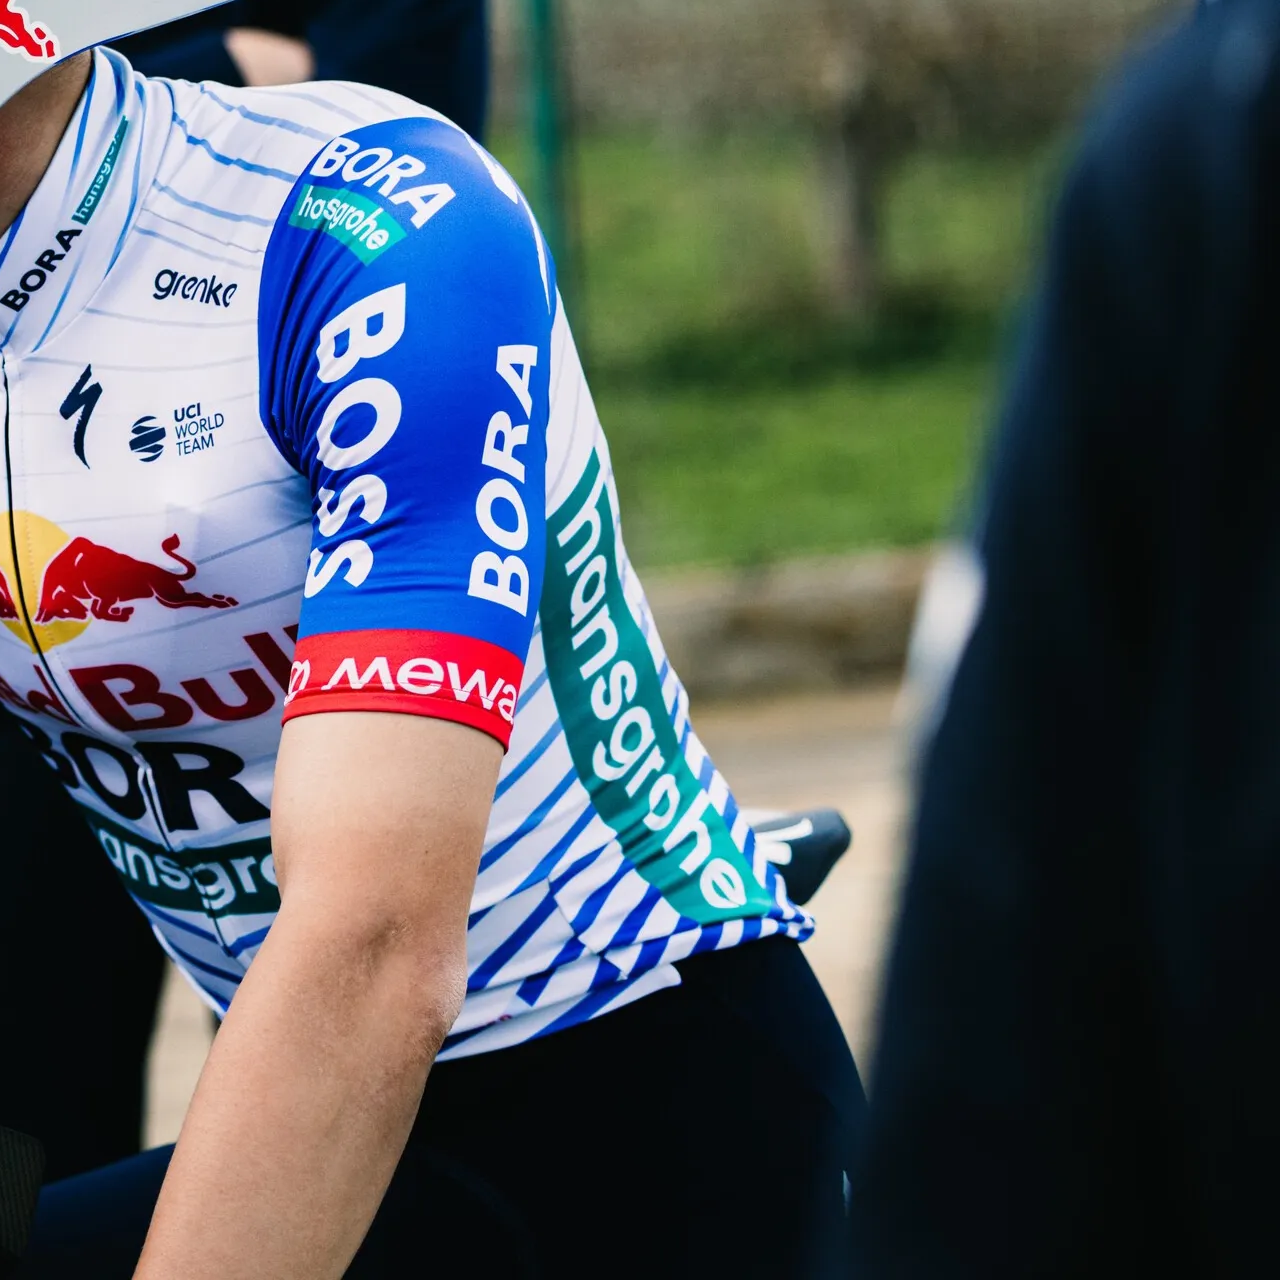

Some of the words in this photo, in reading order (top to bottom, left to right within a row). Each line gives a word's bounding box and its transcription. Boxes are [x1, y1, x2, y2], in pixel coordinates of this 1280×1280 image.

[309, 136, 456, 229] BORA
[0, 227, 83, 313] BORA
[173, 402, 202, 423] UCI
[174, 412, 225, 440] WORLD
[176, 433, 215, 457] TEAM
[304, 282, 407, 599] BOSS
[467, 344, 538, 618] BORA
[321, 655, 519, 725] mewa
[556, 466, 748, 910] hansgrohe
[19, 722, 271, 833] BOR
